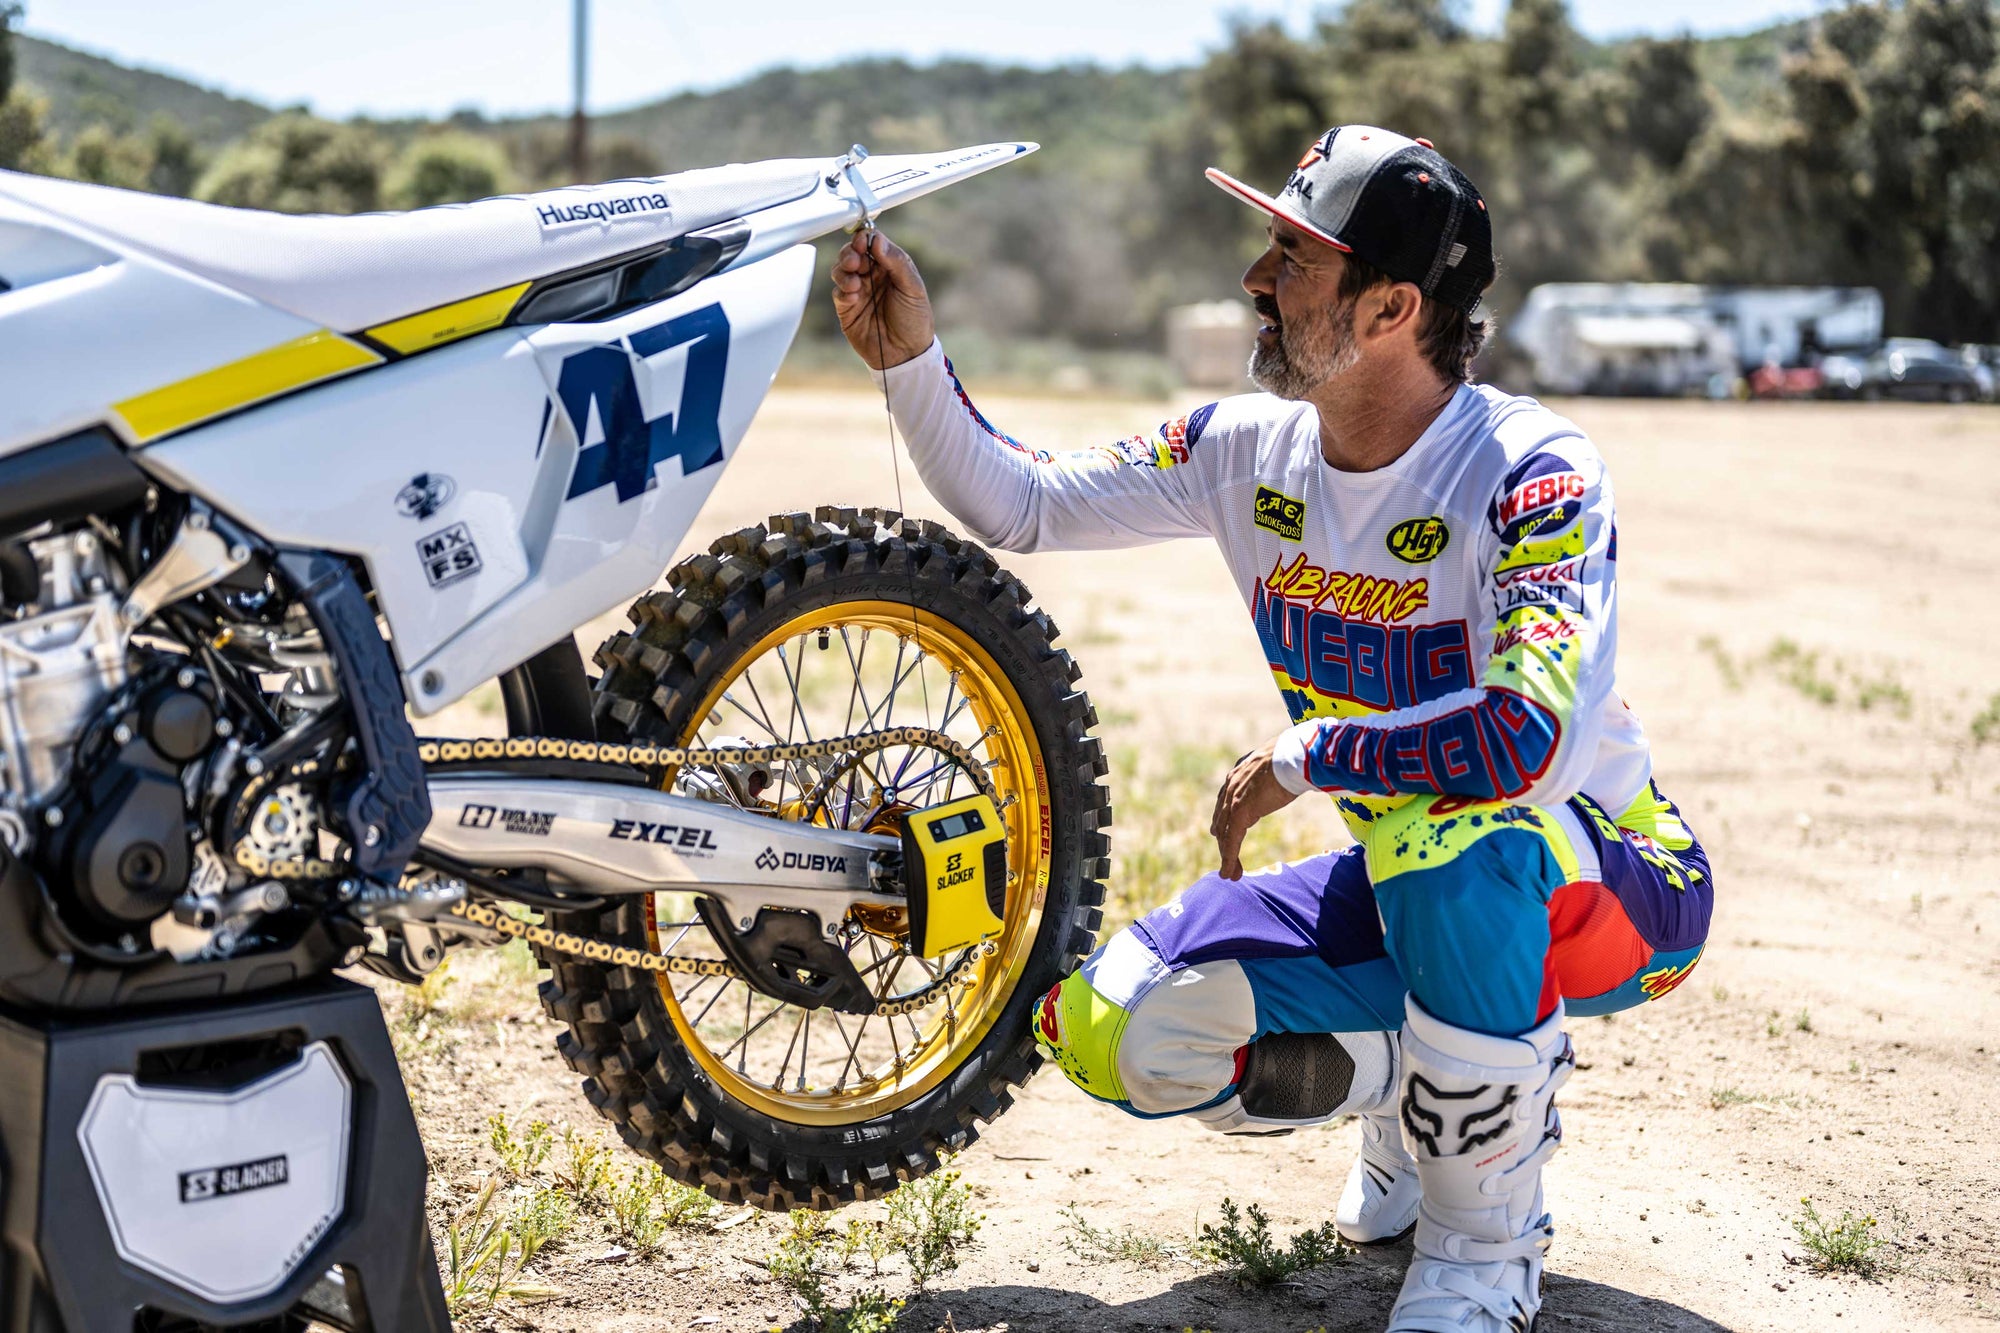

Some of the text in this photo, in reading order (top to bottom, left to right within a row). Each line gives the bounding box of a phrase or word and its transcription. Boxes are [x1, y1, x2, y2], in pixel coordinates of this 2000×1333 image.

[537, 193, 669, 225] Husqvarna
[535, 301, 730, 504] 47
[1255, 497, 1302, 528] CAEL
[1499, 474, 1585, 526] WEBIG
[423, 528, 466, 558] MX
[431, 549, 474, 580] FS
[1313, 571, 1429, 623] RACING
[1252, 576, 1476, 712] WEBIG
[609, 818, 718, 850] EXCEL
[1040, 804, 1050, 860] EXCEL
[782, 851, 847, 874] DUBYA
[937, 867, 975, 890] SLACKER
[220, 1158, 286, 1193] SLACKER
